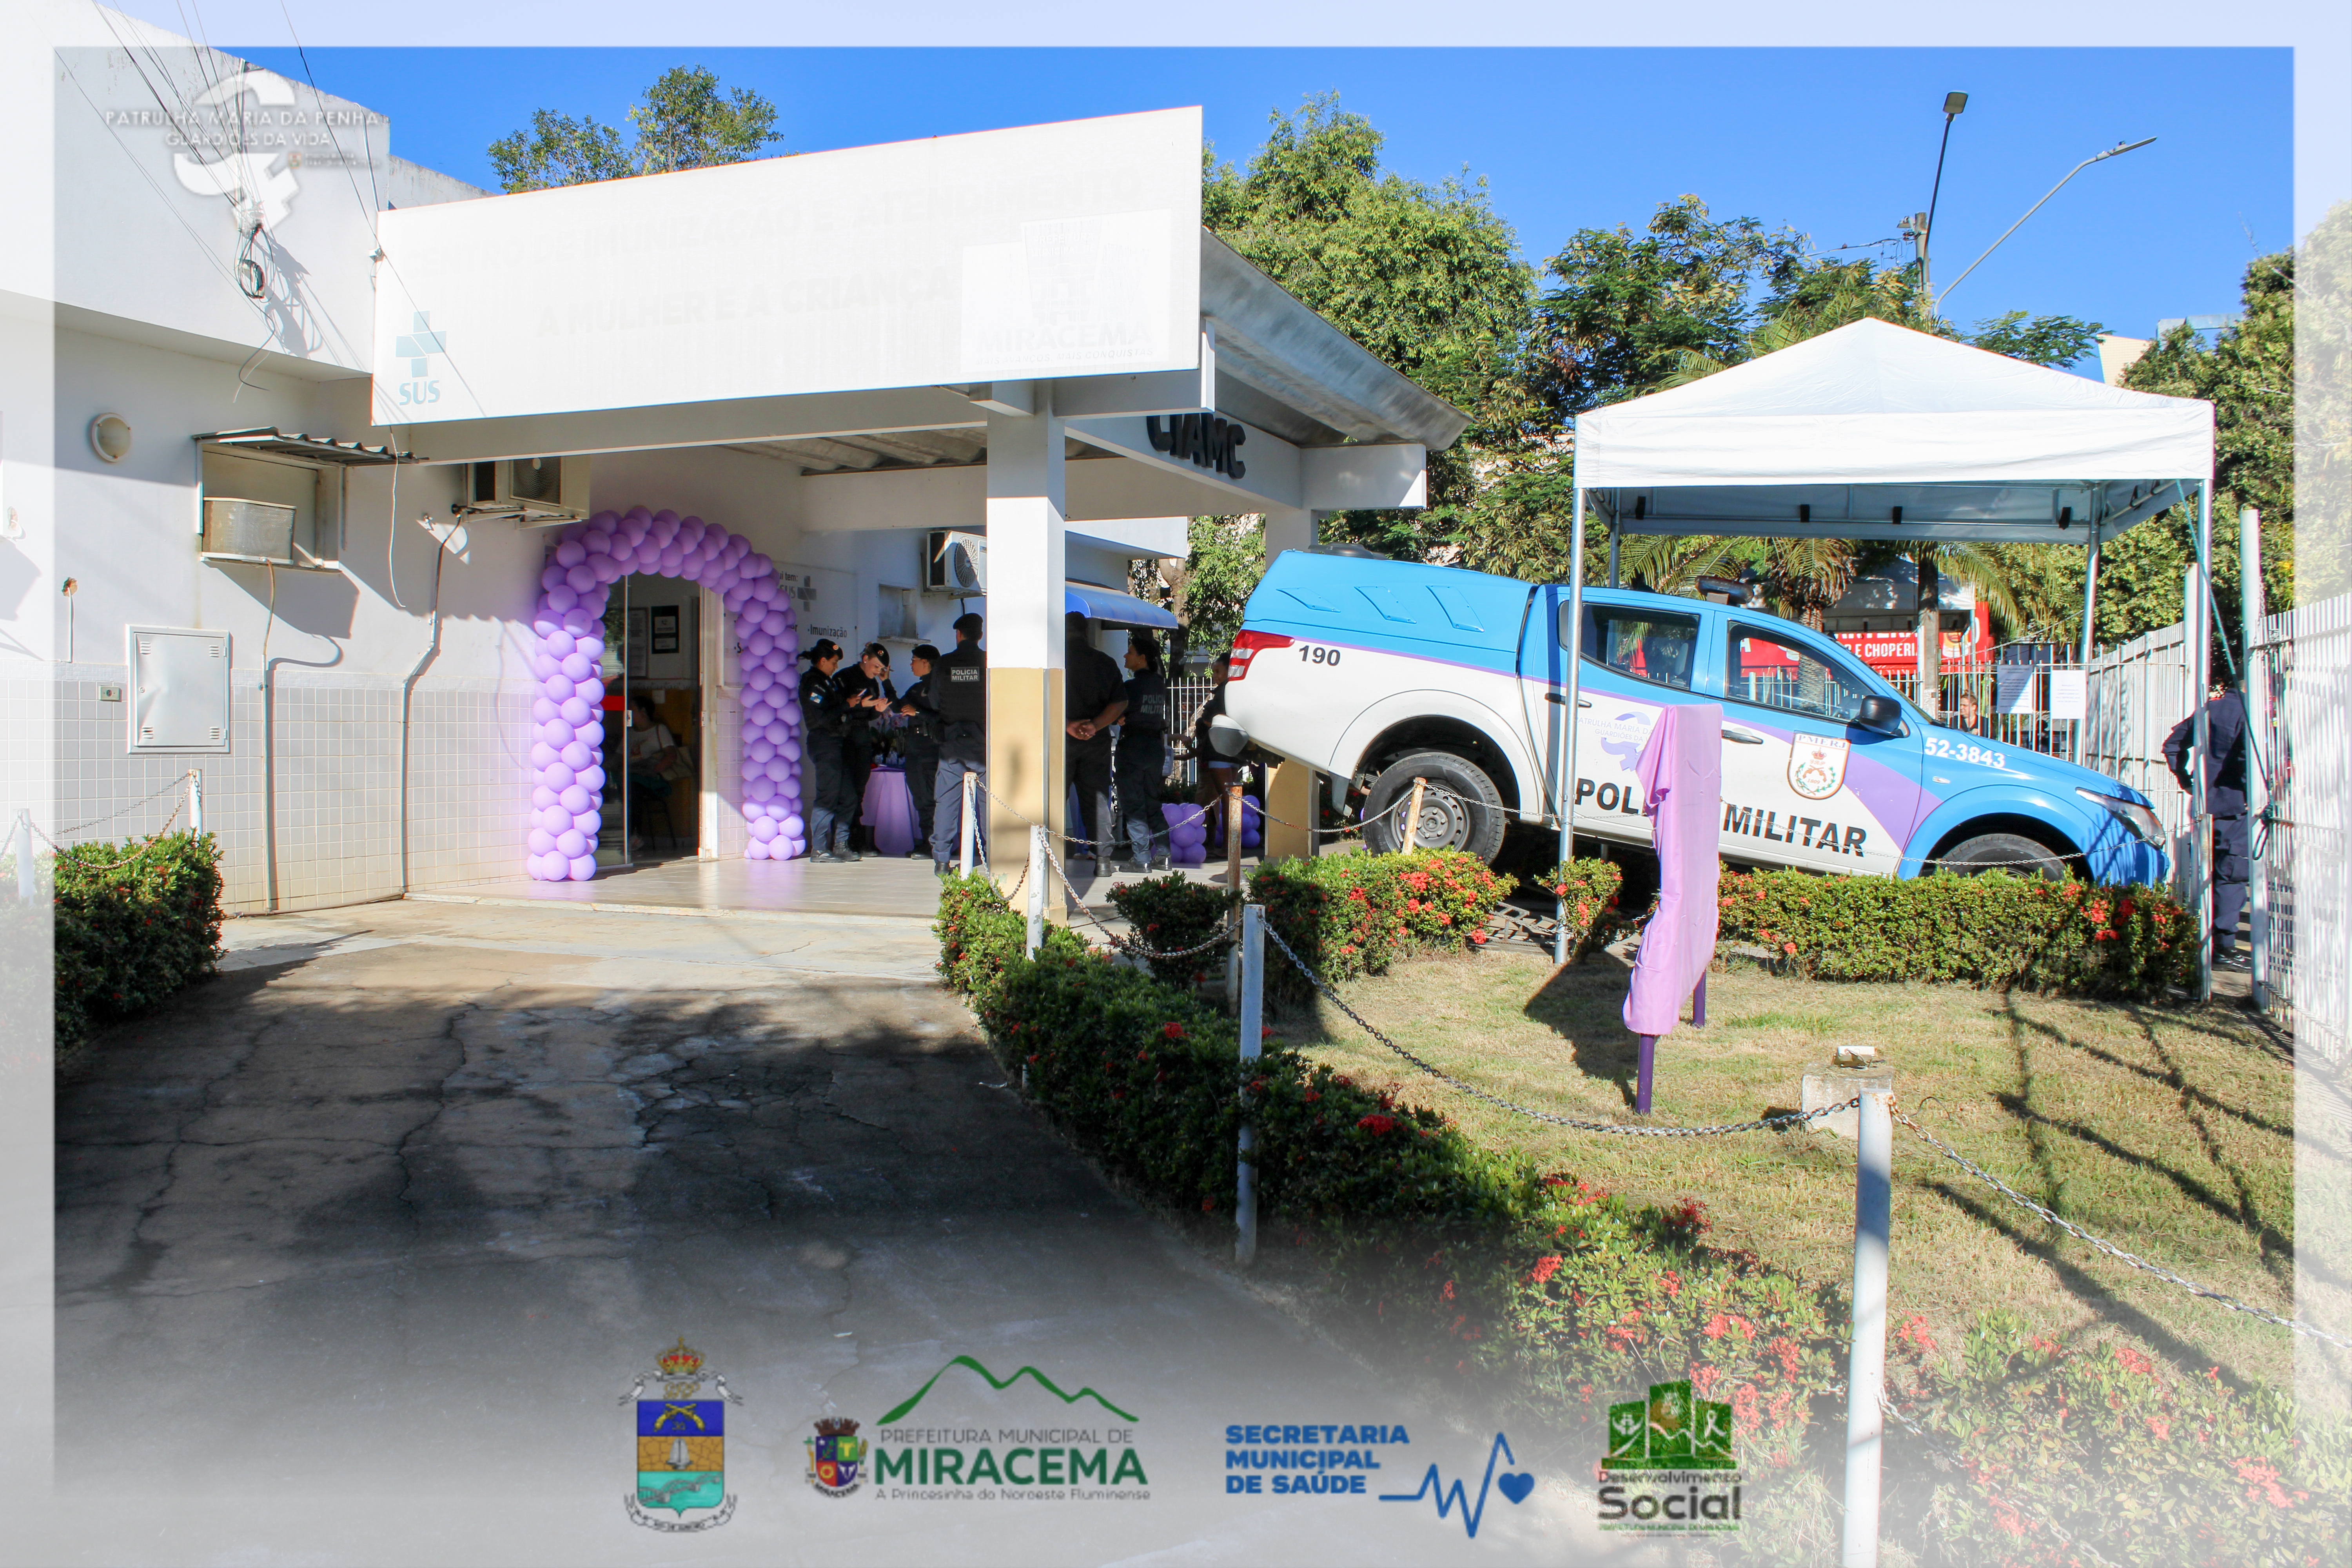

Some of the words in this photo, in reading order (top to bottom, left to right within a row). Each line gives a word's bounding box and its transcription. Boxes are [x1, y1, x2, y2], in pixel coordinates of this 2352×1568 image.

[405, 234, 525, 279] CENTRO
[533, 229, 575, 265] DE
[584, 196, 802, 259] IMUNIZAÇÃO
[812, 198, 834, 233] E
[852, 165, 1142, 228] ATENDIMENTO
[536, 305, 561, 338] A
[568, 289, 706, 335] MULHER
[715, 287, 736, 321] E
[745, 283, 772, 318] A
[780, 265, 954, 314] CRIANÇA
[975, 319, 1153, 353] MIRACEMA
[975, 355, 1000, 365] MAIS
[1057, 351, 1082, 361] MAIS
[1085, 347, 1154, 360] CONQUISTAS
[398, 379, 441, 406] SUS
[785, 572, 798, 582] tem:
[1299, 645, 1341, 666] 190
[1855, 643, 1862, 658] E
[1865, 643, 1918, 657] CHOPERI
[1577, 717, 1612, 729] ATRULHA
[1614, 722, 1641, 734] MARIA
[1595, 728, 1632, 740] GUARDIÕES
[1798, 735, 1846, 748] PMERJ
[1924, 737, 2005, 768] 52-3843
[1723, 804, 1867, 857] MILITAR
